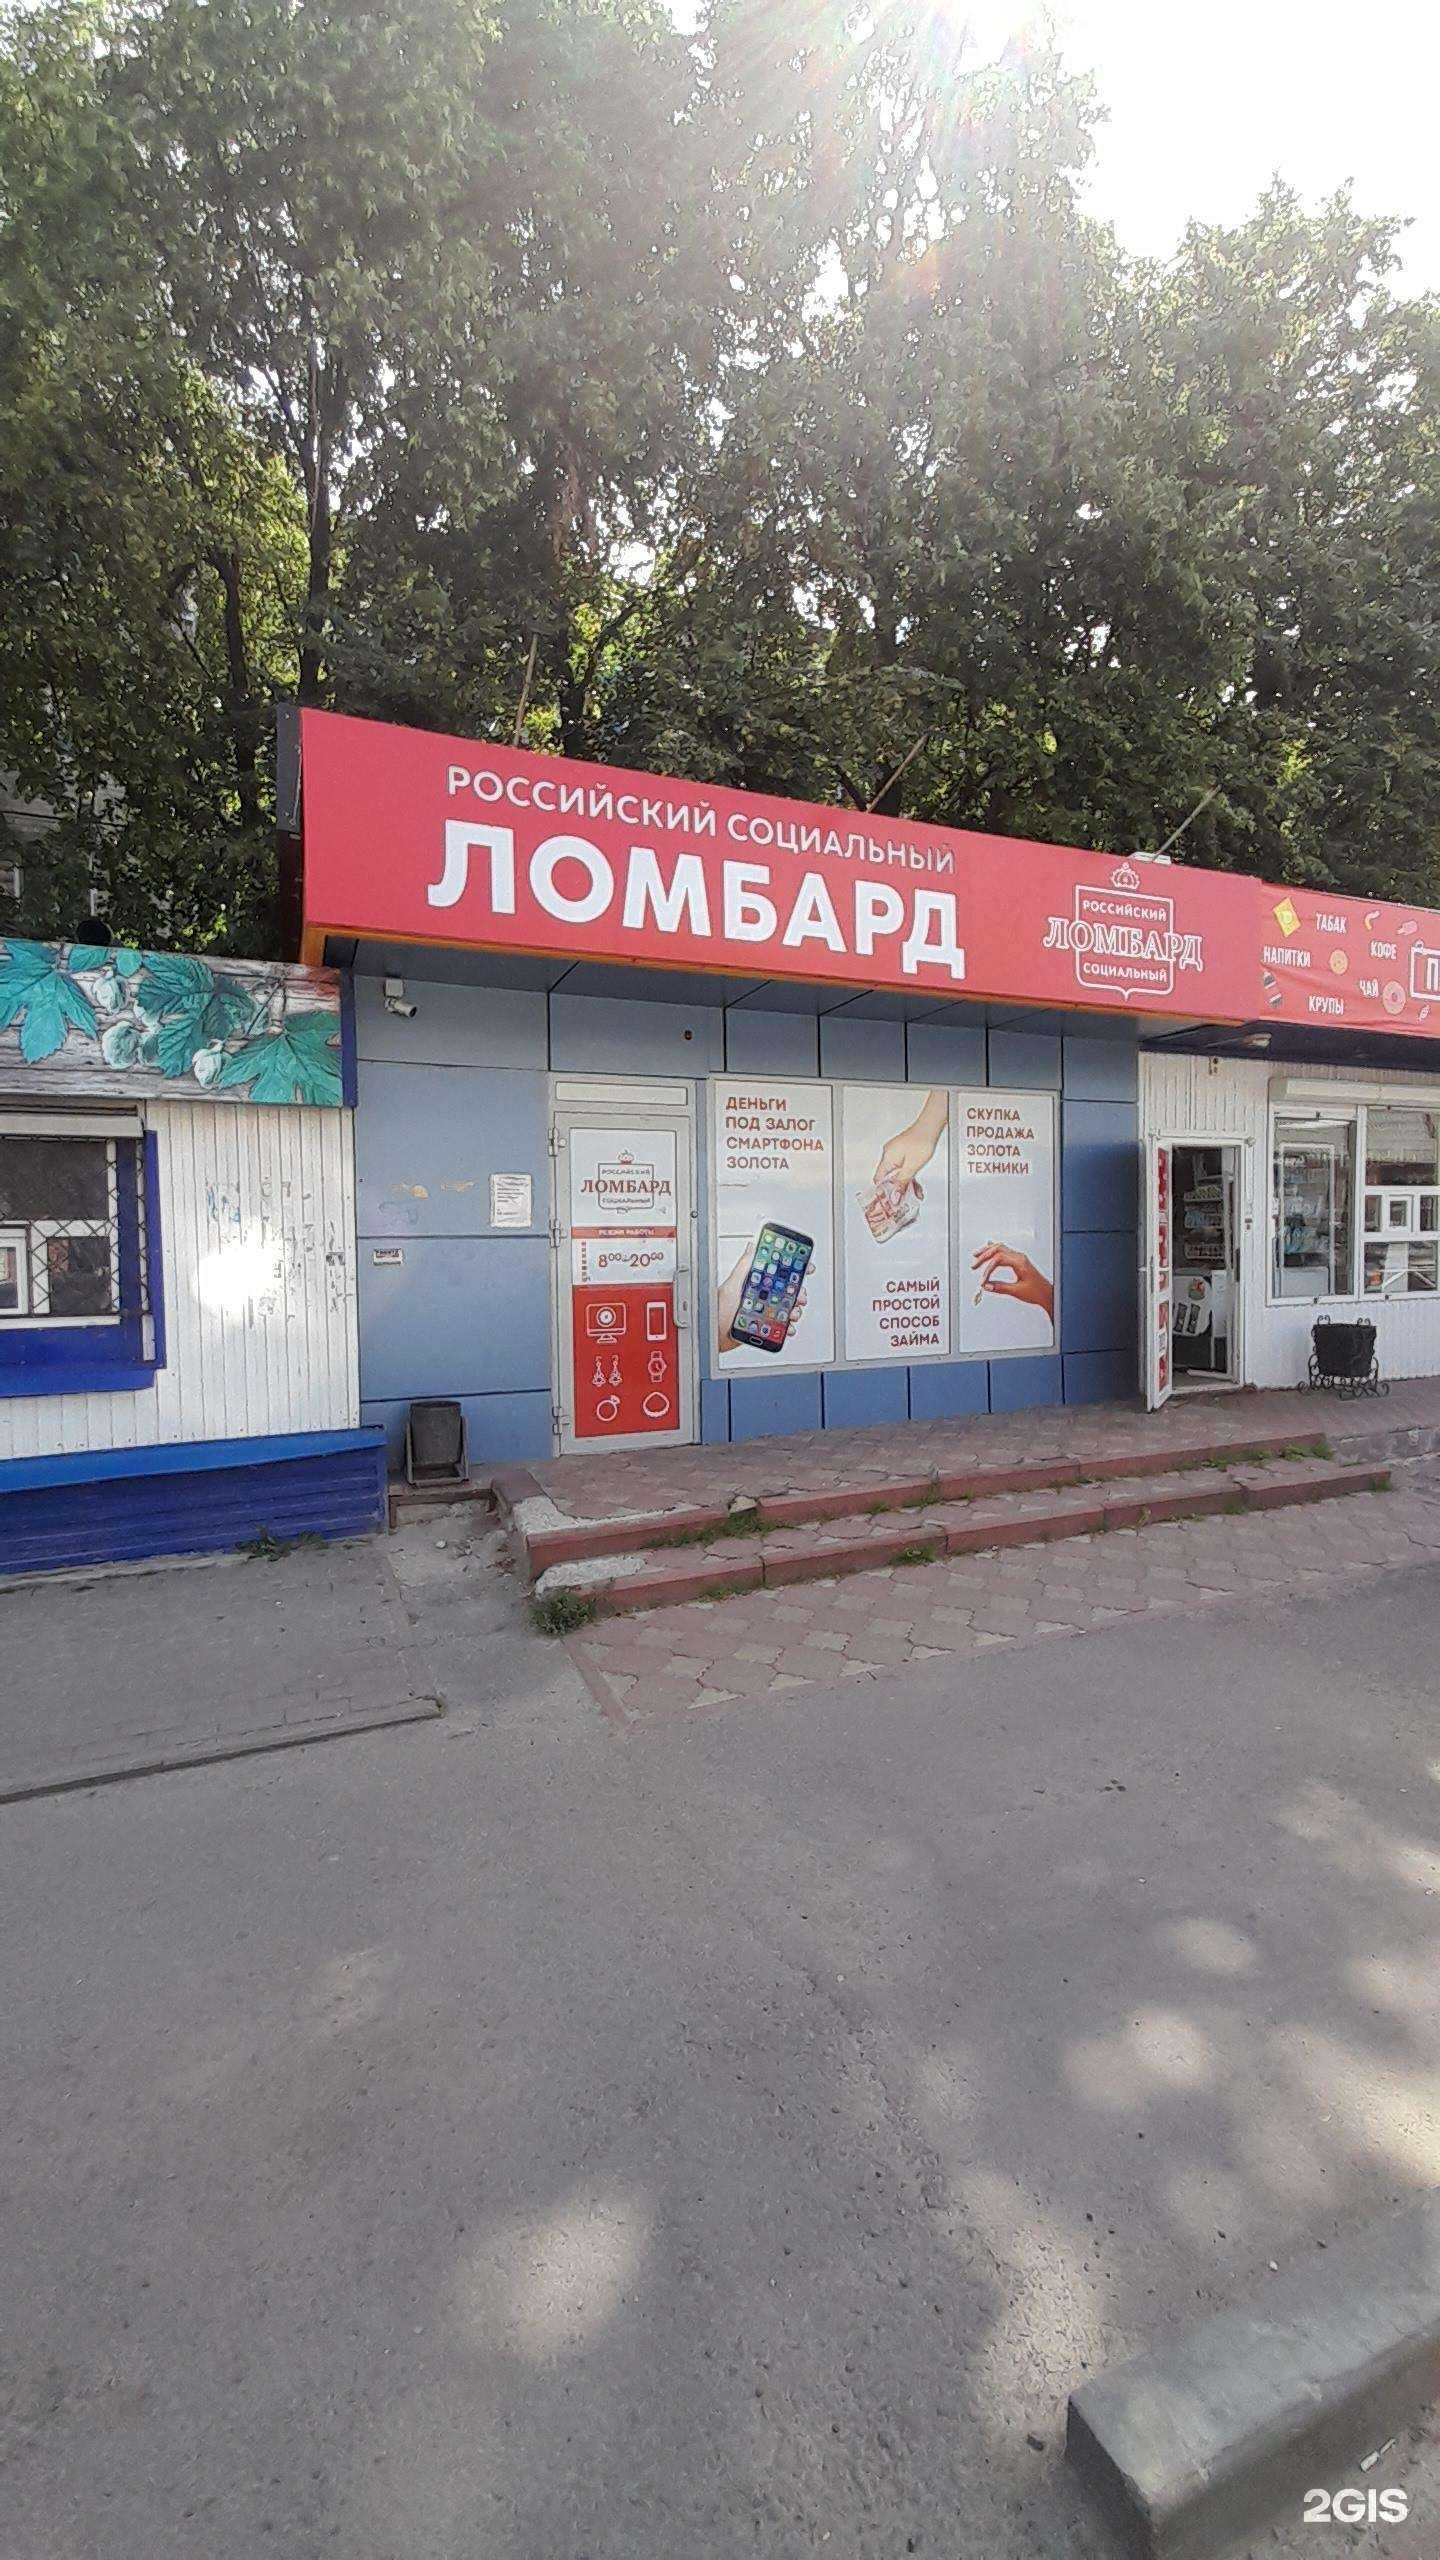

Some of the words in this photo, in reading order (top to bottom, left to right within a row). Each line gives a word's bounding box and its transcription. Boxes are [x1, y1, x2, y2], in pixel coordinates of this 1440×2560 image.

[447, 764, 716, 836] РОССИЙСКИЙ
[727, 813, 956, 874] СОЦИАЛЬНЫЙ
[427, 819, 967, 980] ЛОМБАРД
[1083, 900, 1167, 922] РОССИЙСКИЙ
[1315, 912, 1347, 934] ТАБАК
[1043, 916, 1204, 972] ЛОМБАРД
[1371, 940, 1398, 960] КОФЕ
[1263, 946, 1311, 968] НАПИТКИ
[1083, 962, 1167, 982] СОЦИАЛЬНЫЙ
[1359, 978, 1379, 998] ЧАЙ
[1309, 995, 1344, 1015] КРУПЫ
[726, 1096, 787, 1112] ДЕНЬГИ
[967, 1107, 1020, 1121] СКУПКА
[725, 1116, 761, 1131] ПОД
[765, 1117, 816, 1132] ЗАЛОГ
[967, 1125, 1034, 1140] ПРОДАЖА
[726, 1136, 824, 1151] СМАРТФОНА
[967, 1143, 1021, 1157] ЗОЛОТА
[726, 1155, 790, 1169] ЗОЛОТА
[967, 1161, 1029, 1175] ТЕХНИКИ
[580, 1179, 672, 1196] ЛОМБАРД
[886, 1276, 940, 1293] САМЫЙ
[872, 1294, 940, 1311] ПРОСТОЙ
[879, 1315, 940, 1330] СПОСОБ
[890, 1331, 940, 1347] ЗАЙМА
